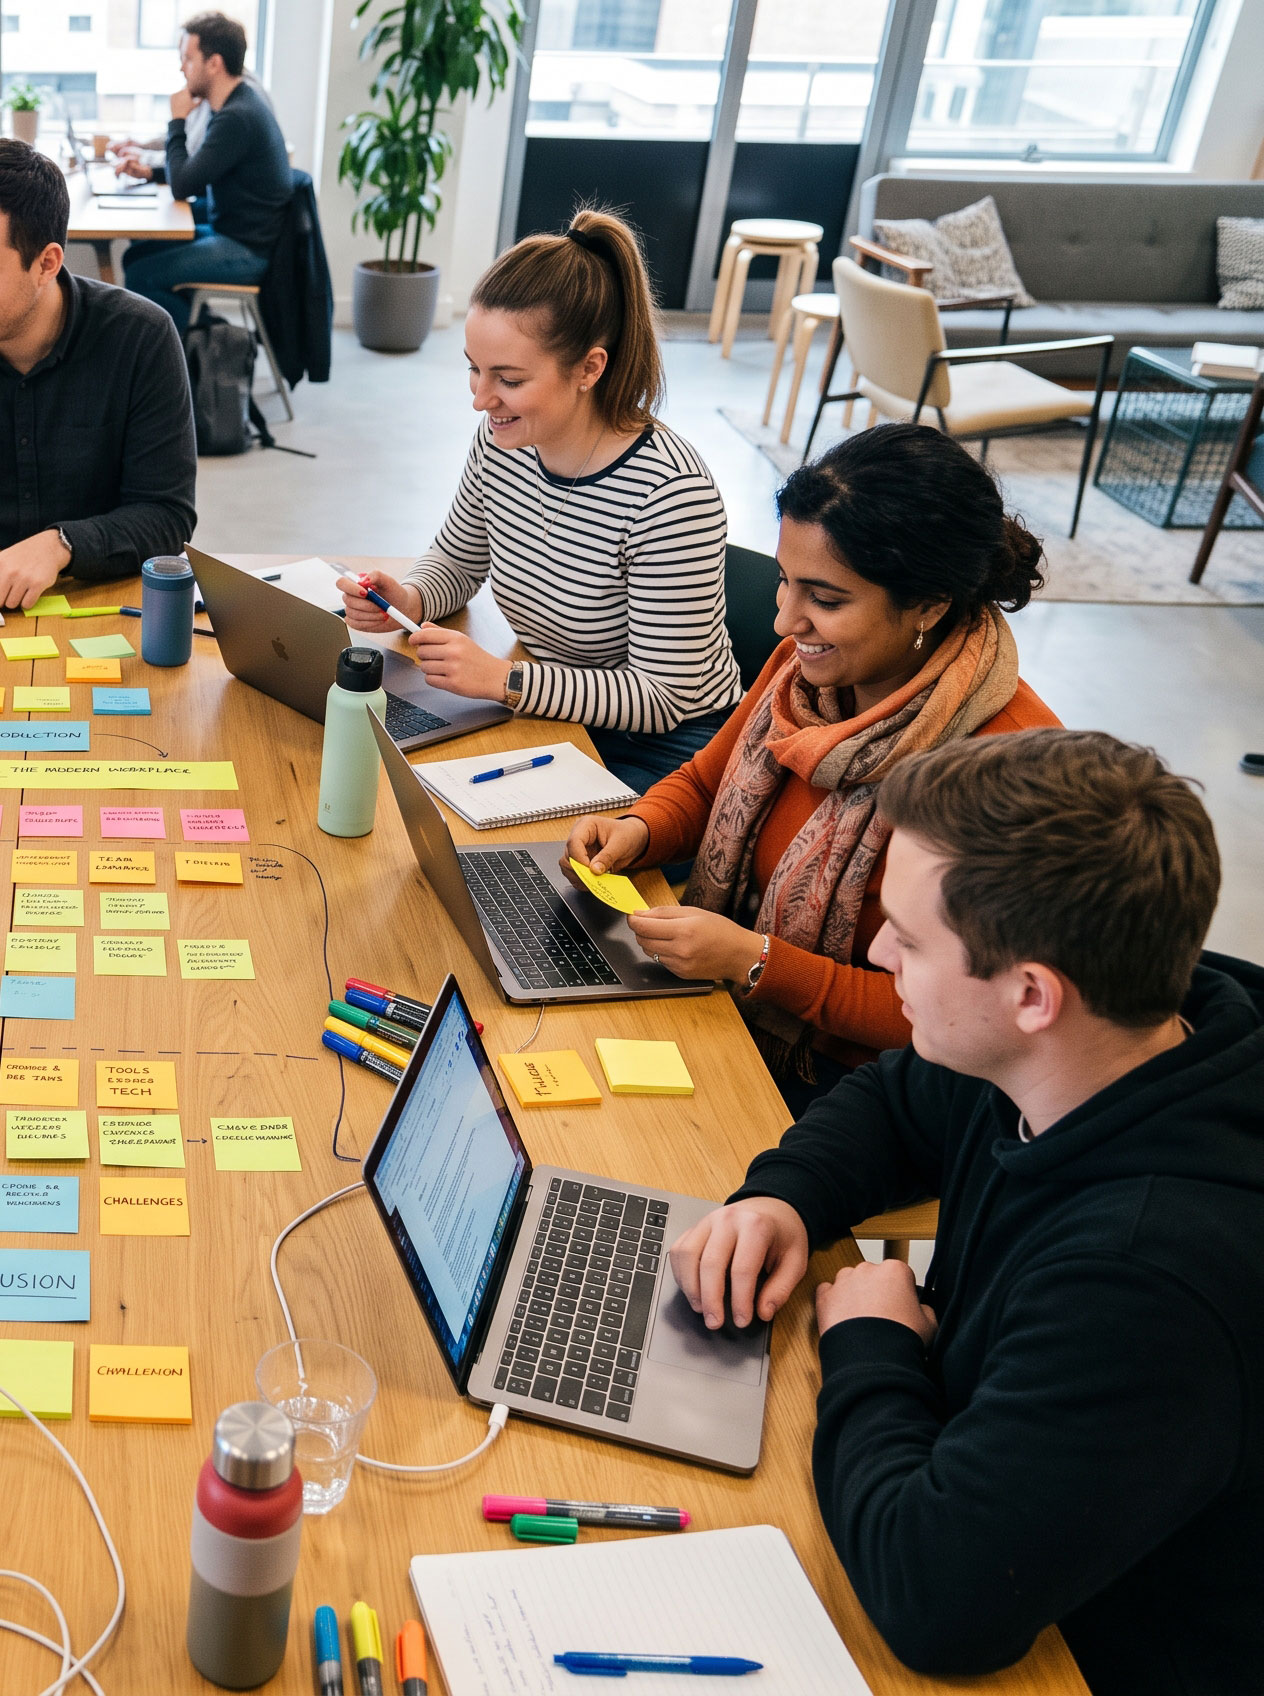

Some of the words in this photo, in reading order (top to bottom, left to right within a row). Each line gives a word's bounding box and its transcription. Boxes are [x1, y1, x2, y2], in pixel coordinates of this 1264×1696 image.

[105, 1066, 150, 1074] TOOLS
[109, 1087, 152, 1096] TECH
[103, 1196, 184, 1207] CHALLENGES
